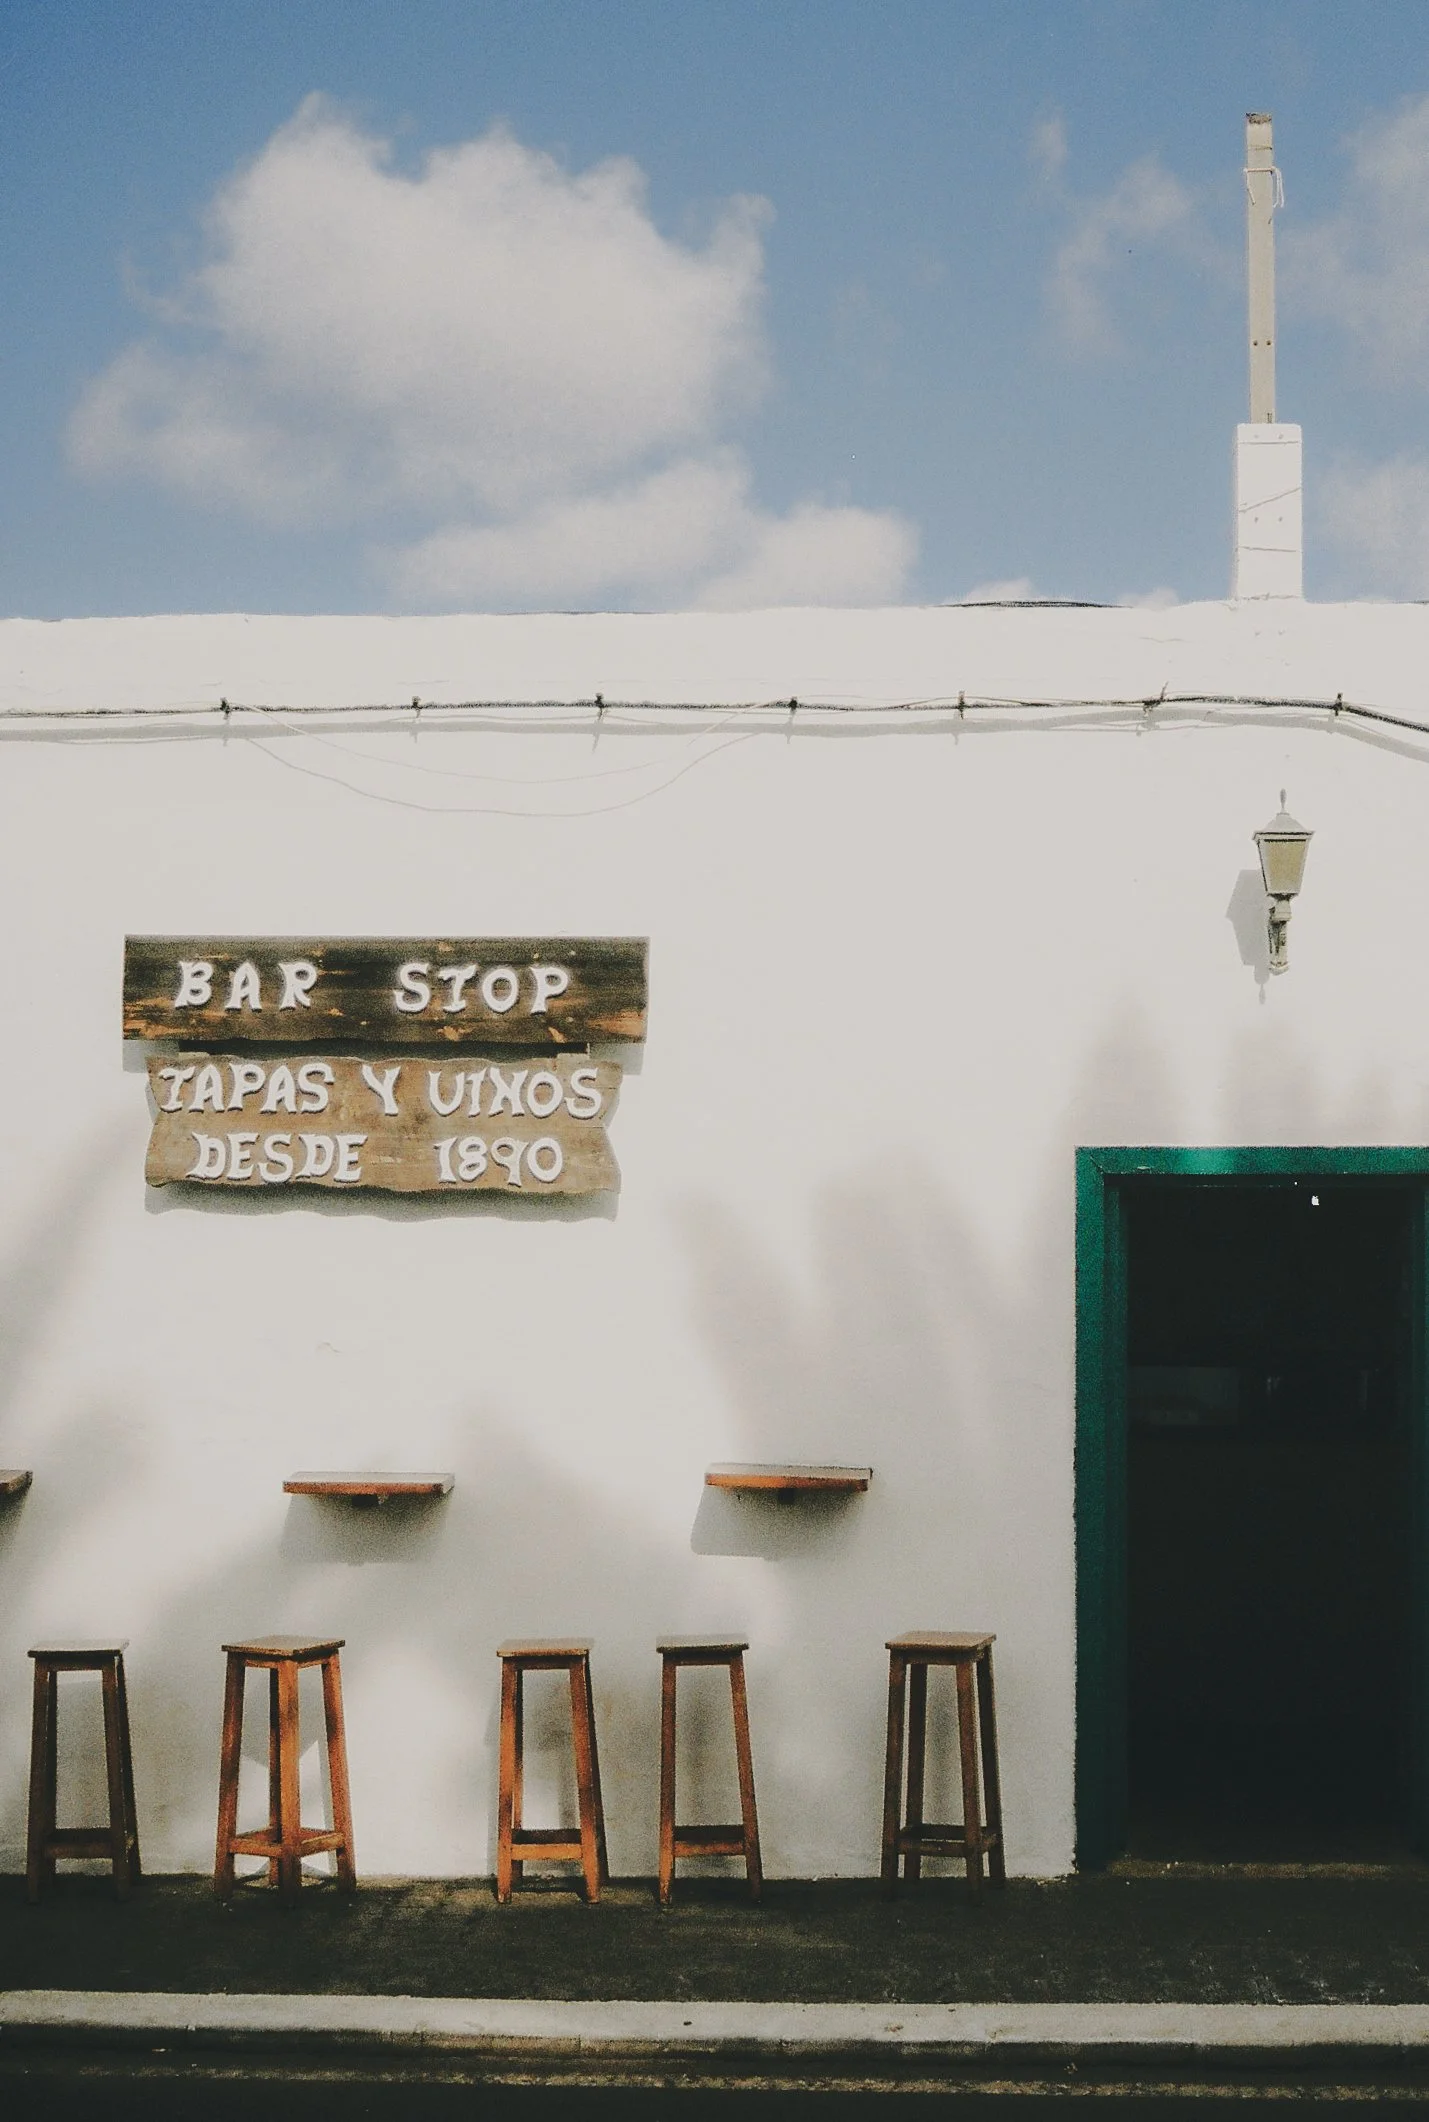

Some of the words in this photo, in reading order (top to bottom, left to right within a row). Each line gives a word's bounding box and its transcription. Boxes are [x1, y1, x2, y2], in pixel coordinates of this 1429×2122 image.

[173, 960, 320, 1012] BAR
[393, 961, 570, 1015] STOP
[157, 1062, 336, 1114] TAPAS
[361, 1065, 402, 1116] Y
[185, 1131, 369, 1184] DESDE
[433, 1136, 564, 1187] 1890
